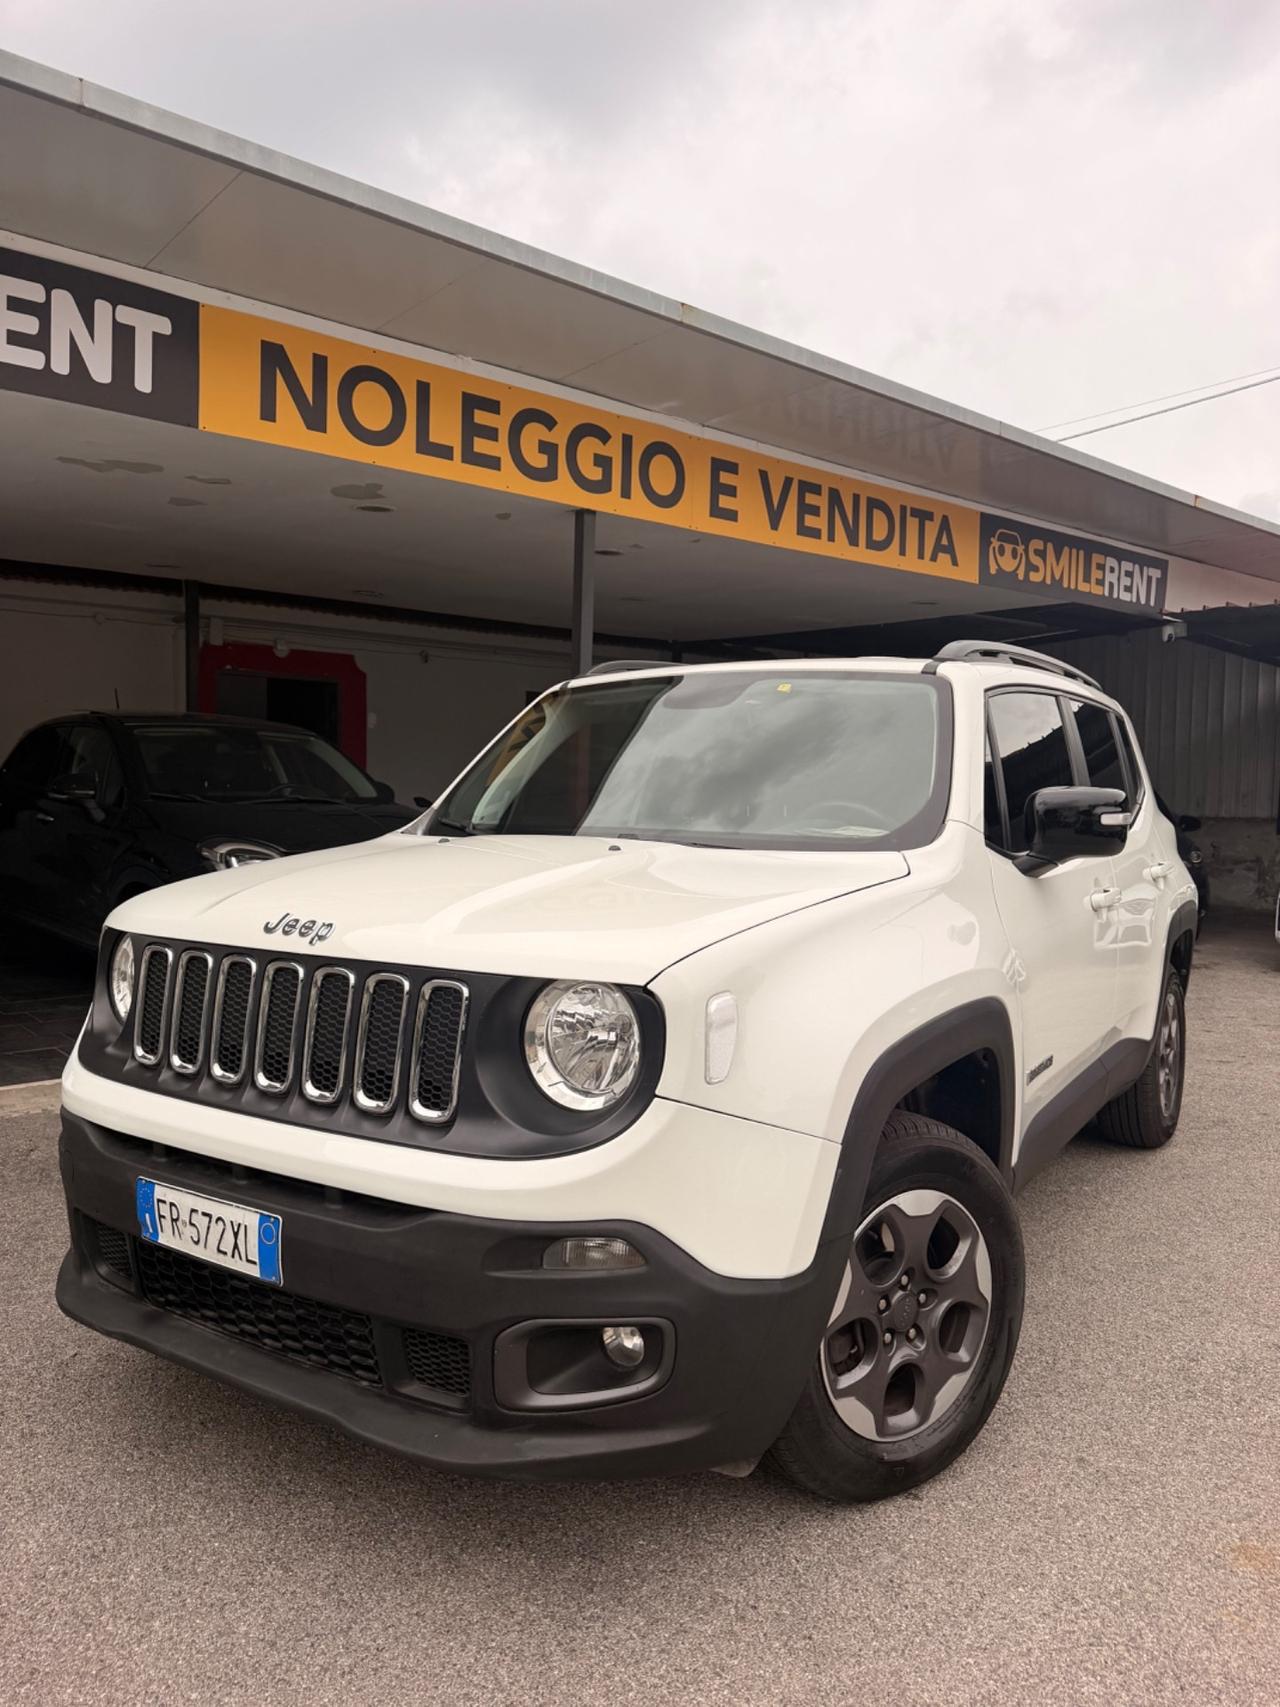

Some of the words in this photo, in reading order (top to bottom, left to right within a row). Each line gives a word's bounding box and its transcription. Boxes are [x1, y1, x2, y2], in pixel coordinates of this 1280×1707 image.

[260, 339, 685, 508] NOLEGGIO
[709, 457, 739, 522] E
[758, 469, 959, 567] VENDITA
[1028, 538, 1161, 607] SMILERENT
[263, 912, 335, 946] Jeep
